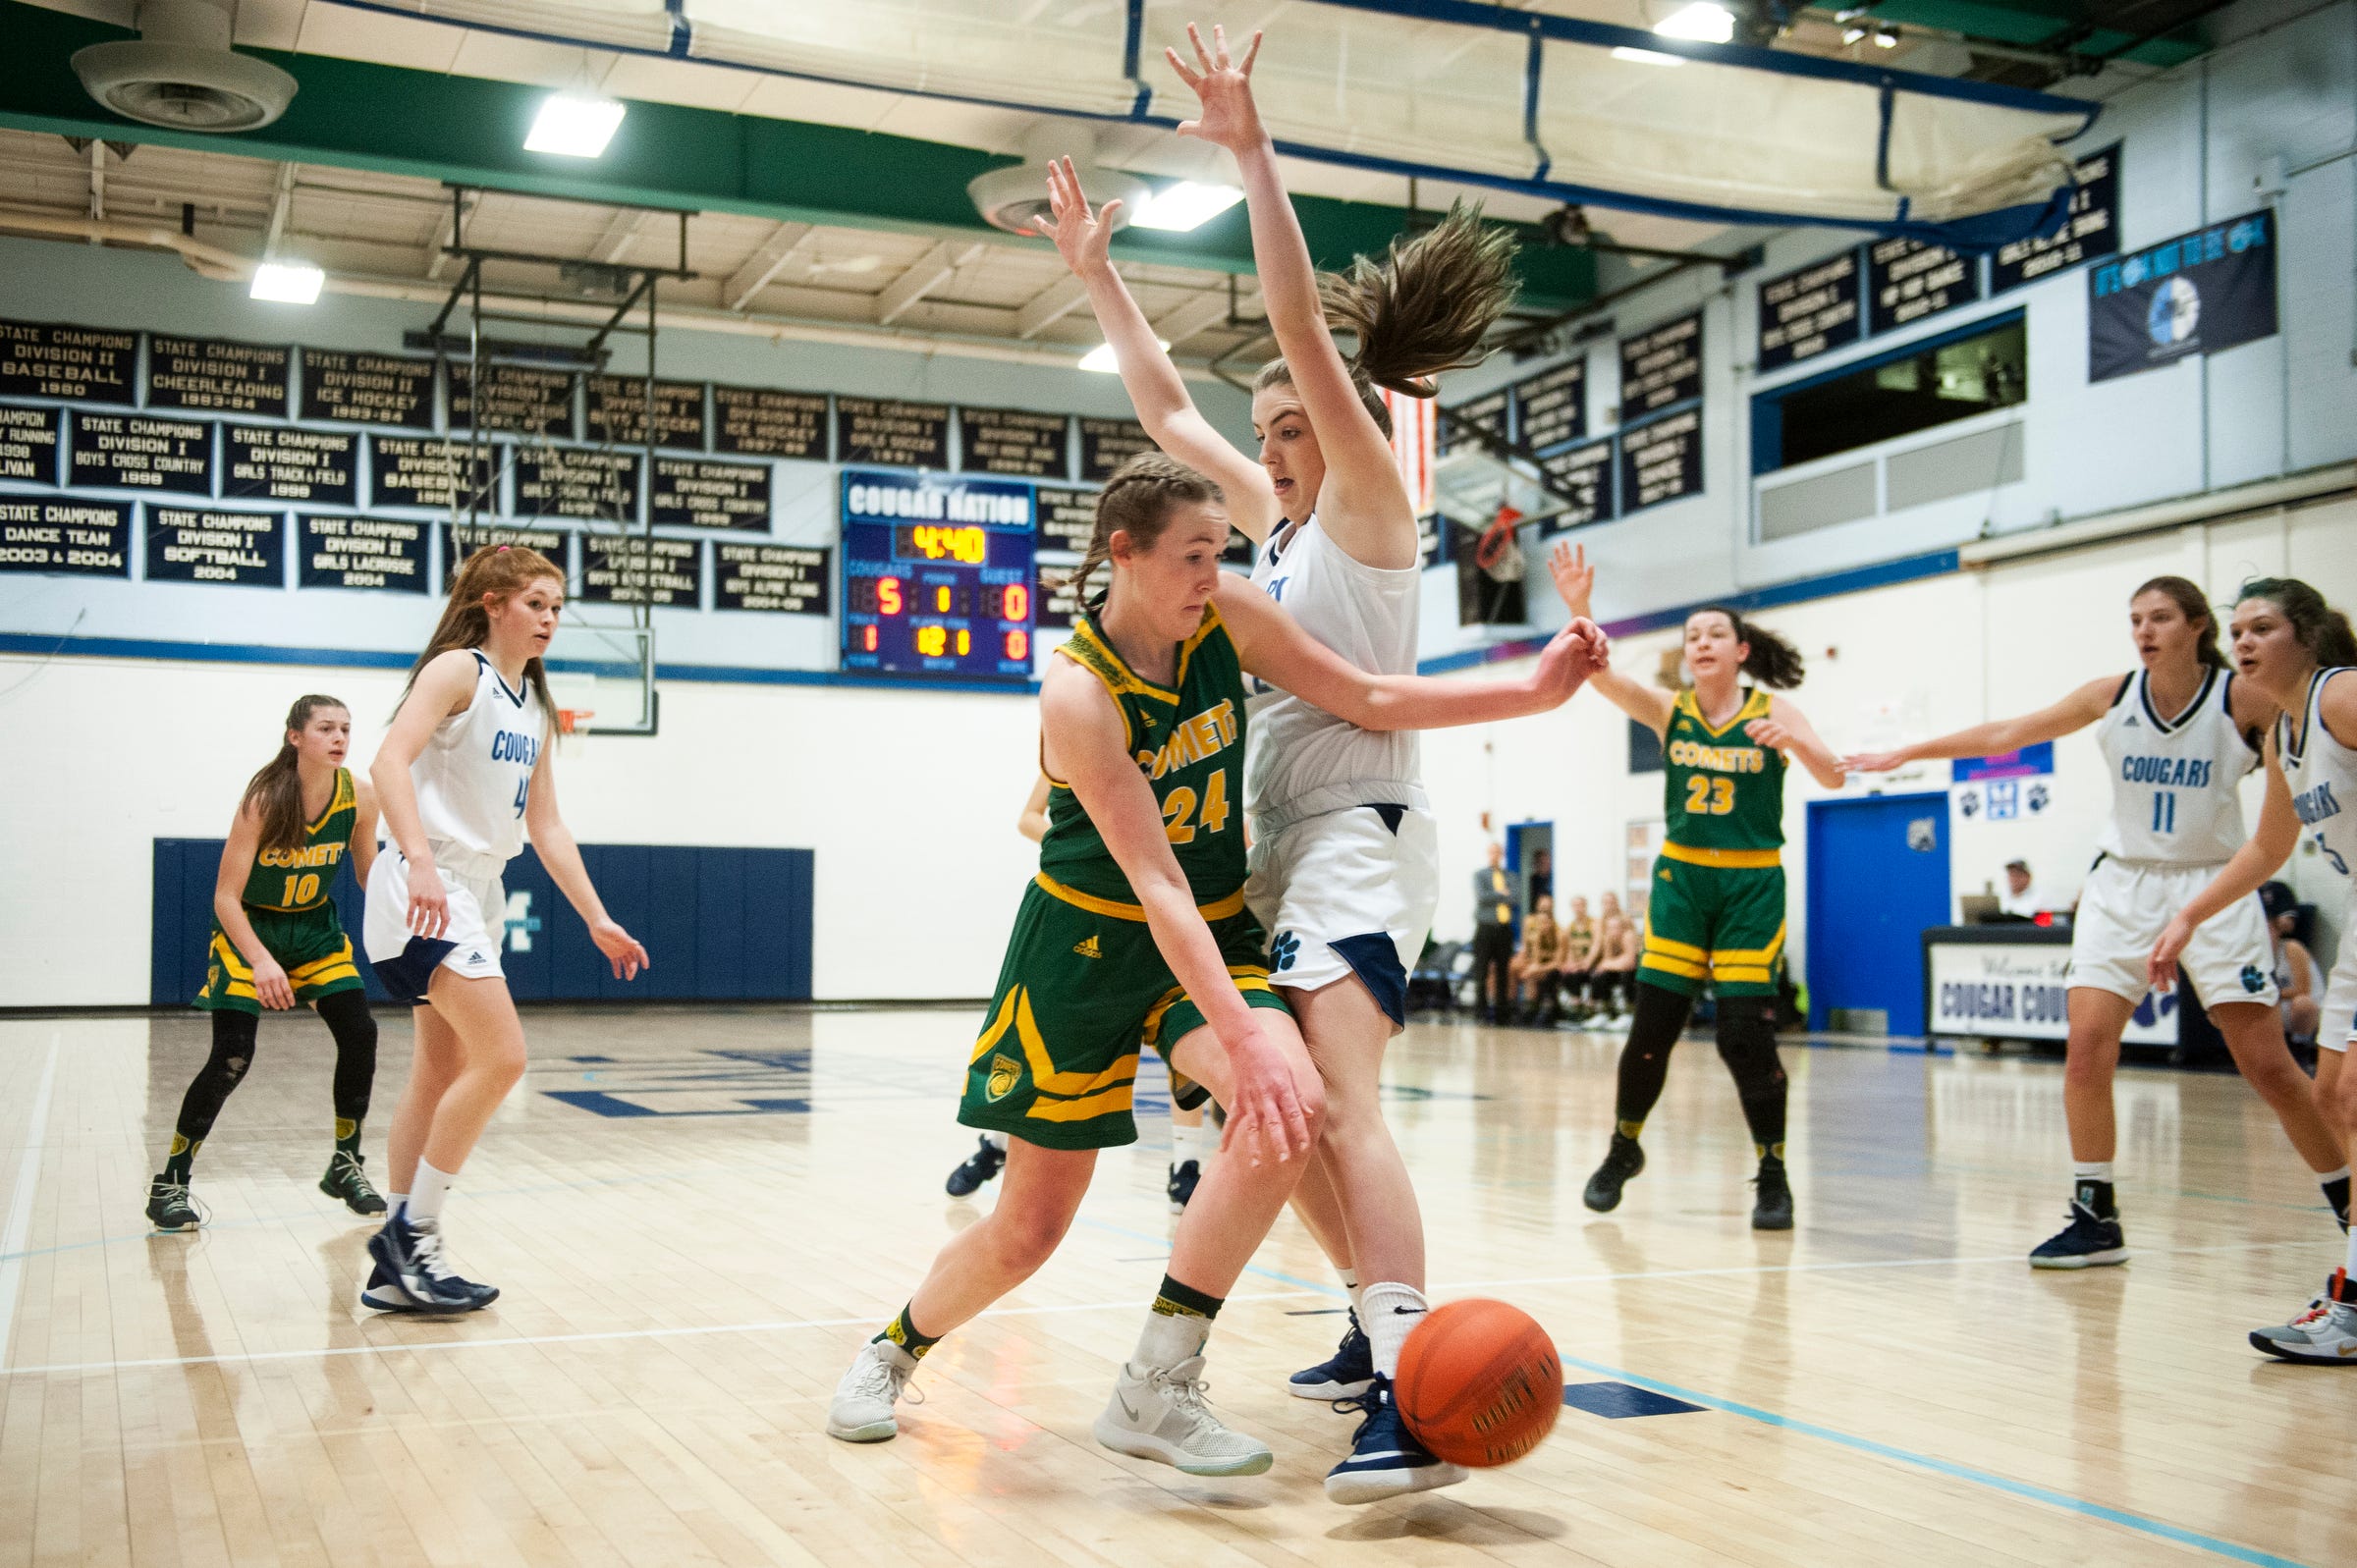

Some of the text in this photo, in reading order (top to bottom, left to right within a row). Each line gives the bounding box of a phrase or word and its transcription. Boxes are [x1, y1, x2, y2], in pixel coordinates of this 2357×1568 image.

[0, 325, 134, 351] STATE CHAMPIONS
[15, 344, 116, 366] DIVISION II
[155, 339, 285, 364] STATE CHAMPIONS
[305, 351, 348, 371] STATE
[2, 361, 123, 385] BASEBALL
[172, 358, 265, 381] DIVISION I
[153, 374, 284, 401] CHEERLEADING
[324, 371, 394, 391] DIVISION
[316, 387, 417, 409] ICE HOCKEY
[9, 426, 56, 445] RUNNING
[82, 416, 203, 441] STATE CHAMPIONS
[98, 435, 187, 456] DIVISION I
[233, 428, 349, 452] STATE CHAMPIONS
[379, 439, 420, 457] STATE
[76, 451, 204, 475] BOYS CROSS COUNTRY
[250, 447, 330, 468] DIVISION I
[233, 463, 265, 481] GIRLS
[270, 464, 305, 484] TRACK
[314, 467, 347, 487] FIELD
[658, 460, 694, 478] STATE
[601, 487, 631, 505] FIED
[676, 478, 737, 497] DIVISION
[0, 505, 118, 526] STATE CHAMPIONS
[849, 483, 944, 520] COUGAR
[947, 491, 1030, 526] NATION
[158, 510, 273, 532] STATE CHAMPIONS
[309, 518, 418, 540] STATE CHAMPIONS
[5, 526, 111, 547] DANCE TEAM
[178, 530, 254, 549] DIVISION I
[325, 536, 386, 554] DIVISION
[913, 524, 986, 565] 4:40
[0, 548, 49, 563] 2003
[67, 550, 123, 568] 2004
[164, 546, 267, 568] SOFTBALL
[630, 540, 693, 559] CHMPIONS
[193, 565, 237, 580] 2004
[313, 553, 415, 575] GIRLS LACROSSE
[621, 571, 693, 591] BSETBALL
[877, 576, 903, 616] 5
[937, 585, 951, 614] 1
[1004, 582, 1028, 622] 0
[864, 623, 878, 652] 1
[1006, 628, 1028, 661] 0
[1670, 739, 1764, 774] COMETS
[2122, 755, 2213, 788] COUGARS
[1685, 774, 1735, 815] 23
[1162, 768, 1230, 844] 24
[2152, 790, 2175, 835] 11
[281, 873, 321, 907] 10
[1941, 982, 2014, 1019] COUGAR
